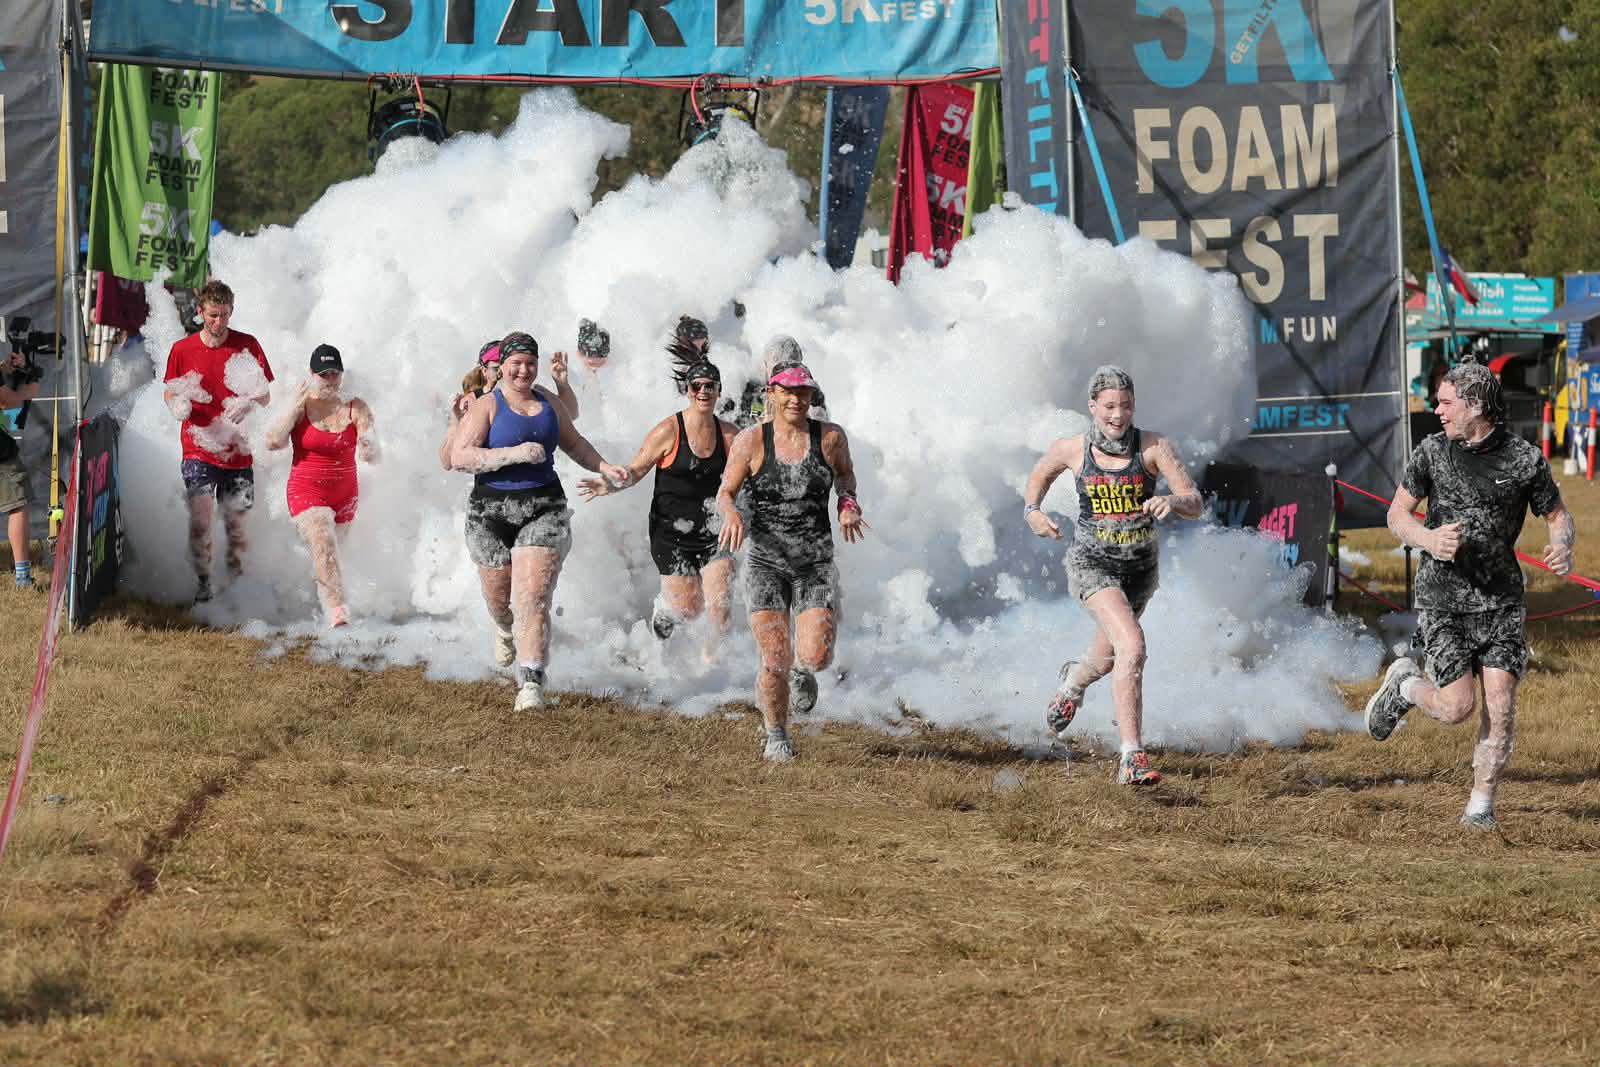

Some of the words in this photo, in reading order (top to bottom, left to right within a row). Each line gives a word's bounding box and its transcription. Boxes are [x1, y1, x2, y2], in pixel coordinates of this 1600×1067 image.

[1134, 0, 1336, 89] 5K
[1230, 0, 1278, 65] GETFILT
[151, 71, 209, 93] FOAM
[149, 88, 207, 110] FEST
[941, 103, 974, 141] 5
[149, 120, 204, 160] 5K
[1134, 103, 1339, 194] FOAM
[147, 152, 202, 176] FOAM
[145, 167, 199, 192] FEST
[139, 201, 197, 242] 5K
[138, 234, 195, 256] FOAM
[1138, 213, 1339, 304] EST
[135, 250, 194, 276] FEST
[1251, 403, 1350, 430] MFEST
[1086, 483, 1144, 499] FORCE
